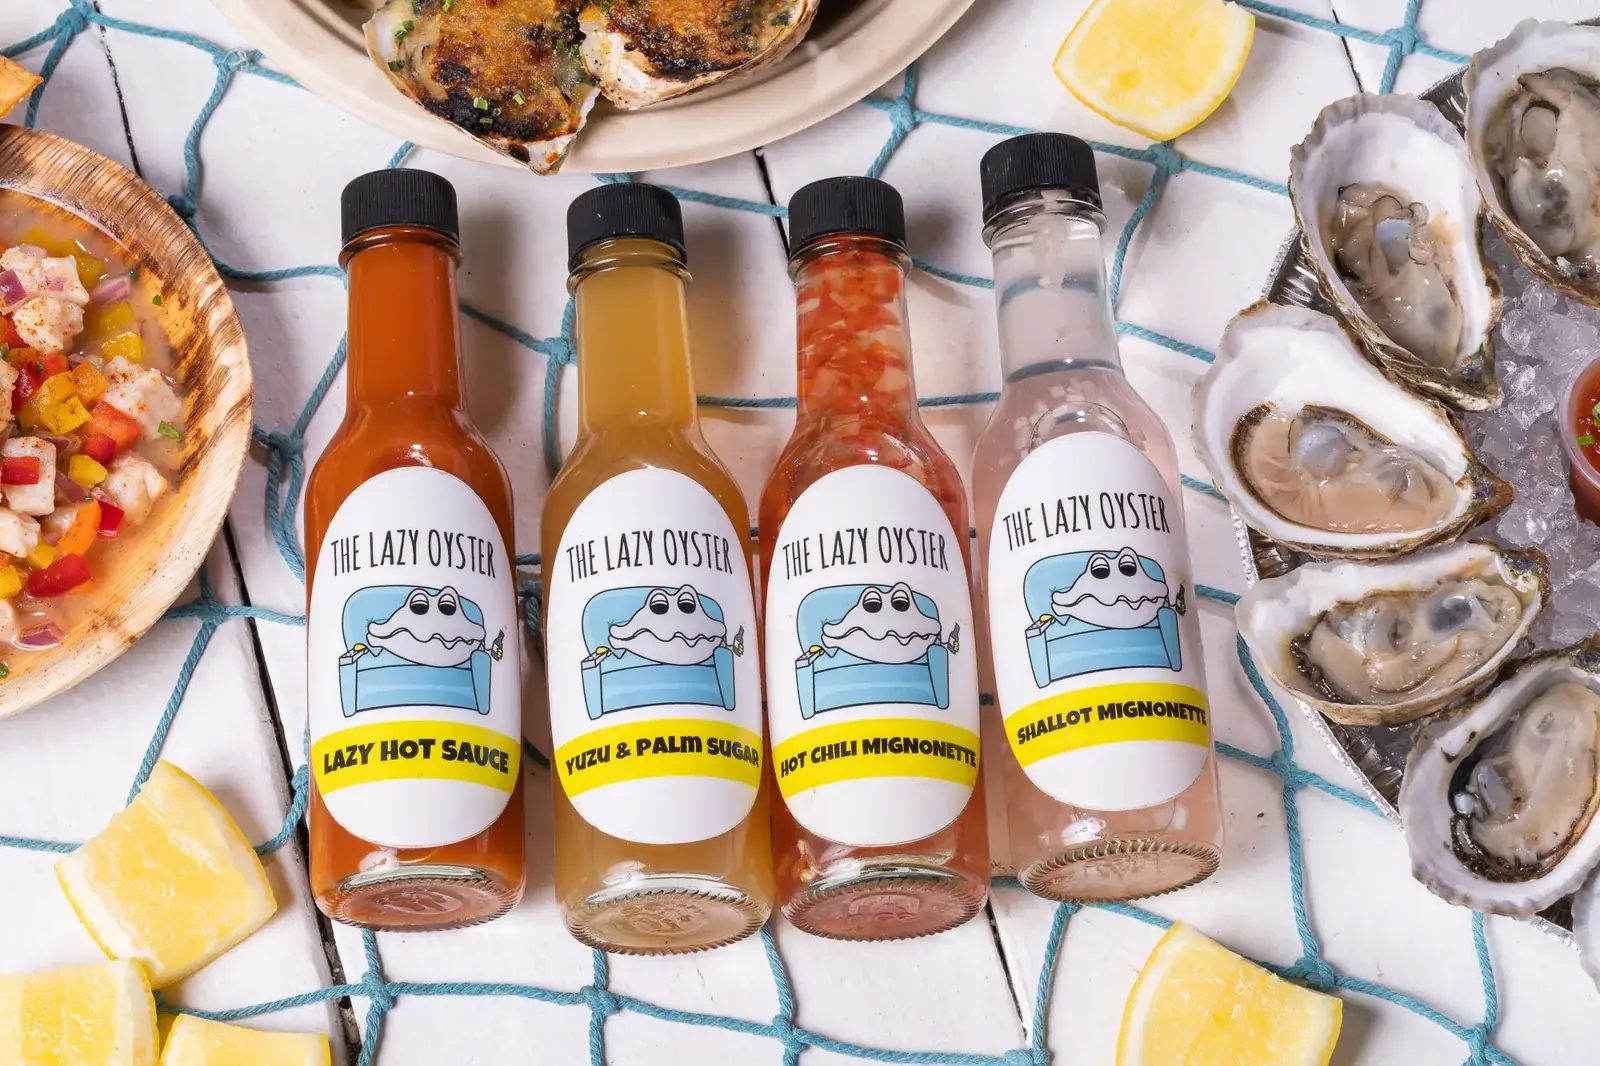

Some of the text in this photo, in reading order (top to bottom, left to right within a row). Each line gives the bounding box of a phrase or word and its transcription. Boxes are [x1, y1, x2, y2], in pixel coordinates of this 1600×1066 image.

[1003, 493, 1170, 550] THE LAZY OYSTER
[331, 530, 495, 578] THE LAZY OYSTER
[565, 529, 733, 582] THE LAZY OYSTER
[783, 527, 948, 579] THE LAZY OYSTER
[1018, 701, 1207, 744] SHALLOT MIGNONETTE
[325, 739, 509, 774] LAZY HOT SAUCE
[566, 745, 610, 775] YUZU
[616, 743, 631, 758] &
[707, 738, 759, 767] SUGAR
[781, 737, 976, 777] HOT CHILI MIGNONETTE
